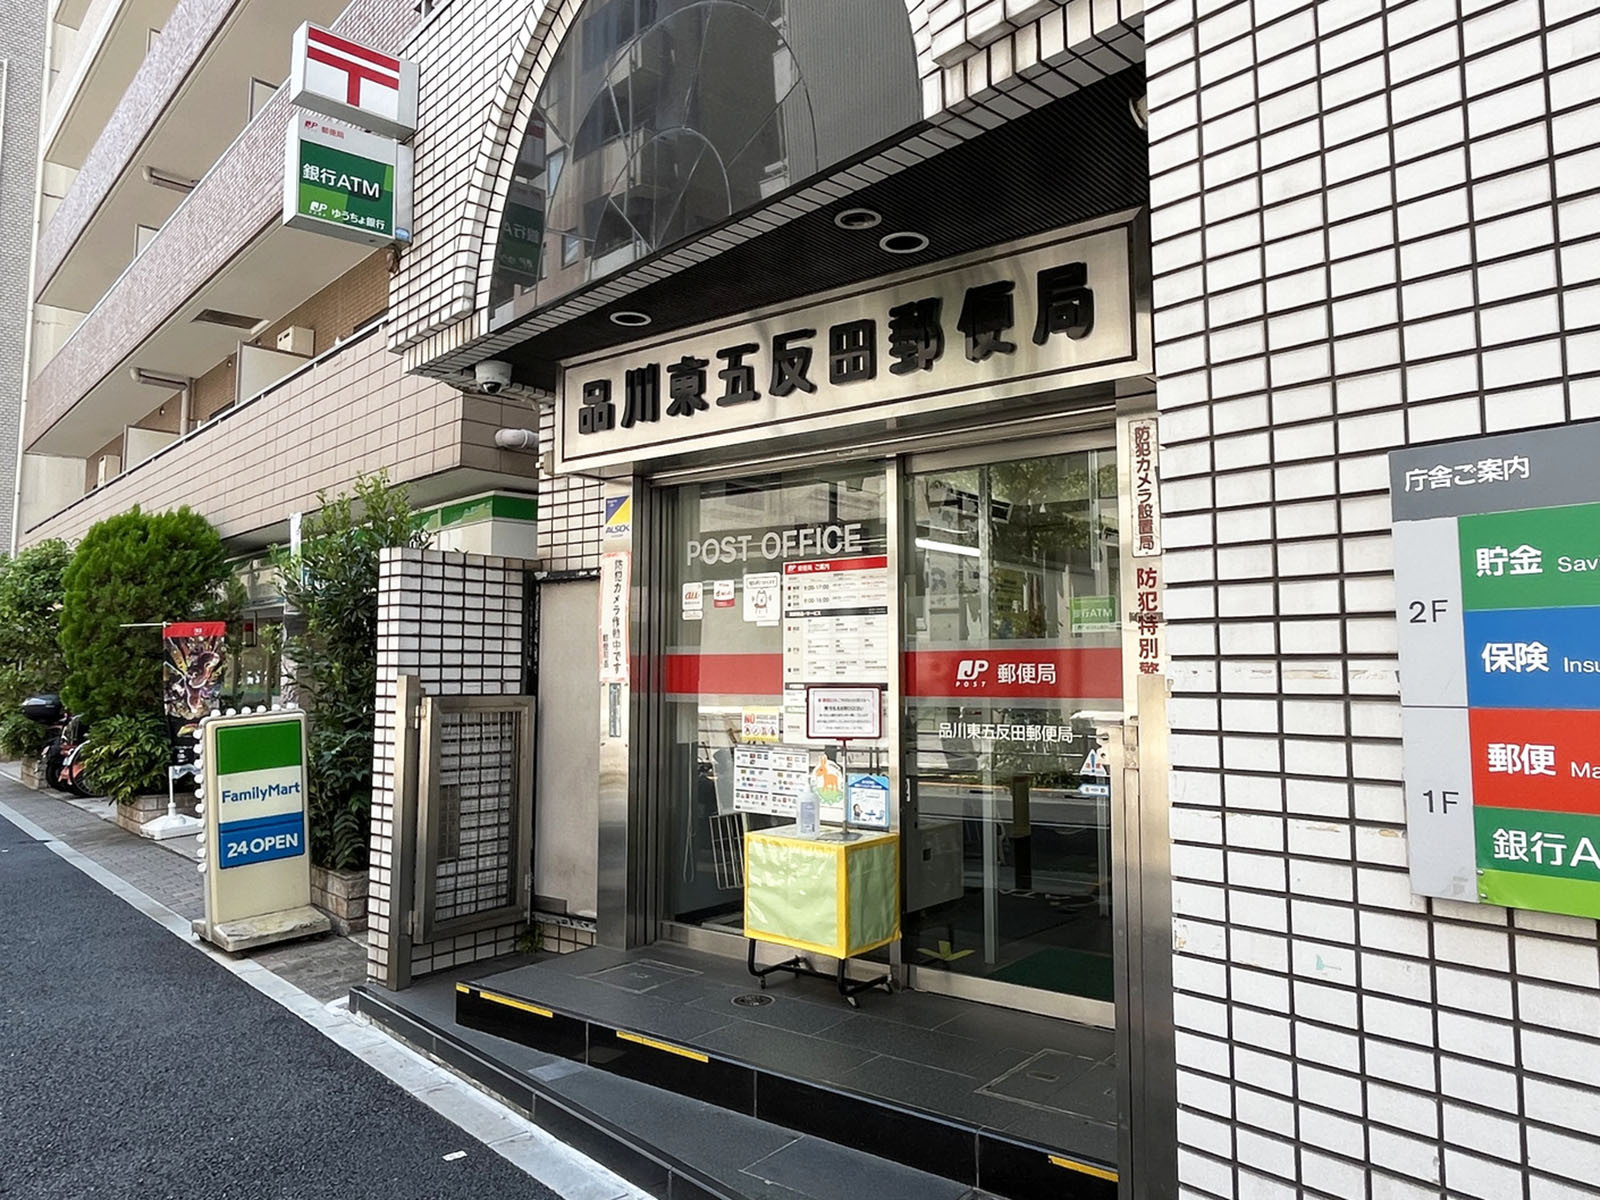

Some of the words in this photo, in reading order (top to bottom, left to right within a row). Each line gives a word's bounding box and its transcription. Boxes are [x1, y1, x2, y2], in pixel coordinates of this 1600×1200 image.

[303, 163, 380, 198] 銀行ATM
[331, 208, 385, 231] ゆうちょ銀行
[578, 261, 1094, 434] 品川東五反田郵便局
[1134, 426, 1155, 551] 防犯カメラ設置局
[1404, 455, 1530, 493] 庁舎ご案内
[687, 535, 752, 566] POST
[761, 523, 862, 561] OFFICE
[1475, 545, 1543, 578] 貯金
[1558, 554, 1600, 573] Sav
[685, 591, 699, 600] au
[1409, 600, 1448, 623] 2F
[1481, 642, 1549, 673] 保険
[997, 663, 1056, 685] 郵便局
[938, 722, 1074, 743] 品川東五反田郵便局
[1487, 743, 1556, 776] 郵便
[1571, 761, 1600, 780] Ma
[222, 783, 300, 803] FamilyMart
[1422, 789, 1459, 814] 1F
[1492, 828, 1600, 870] 銀行A
